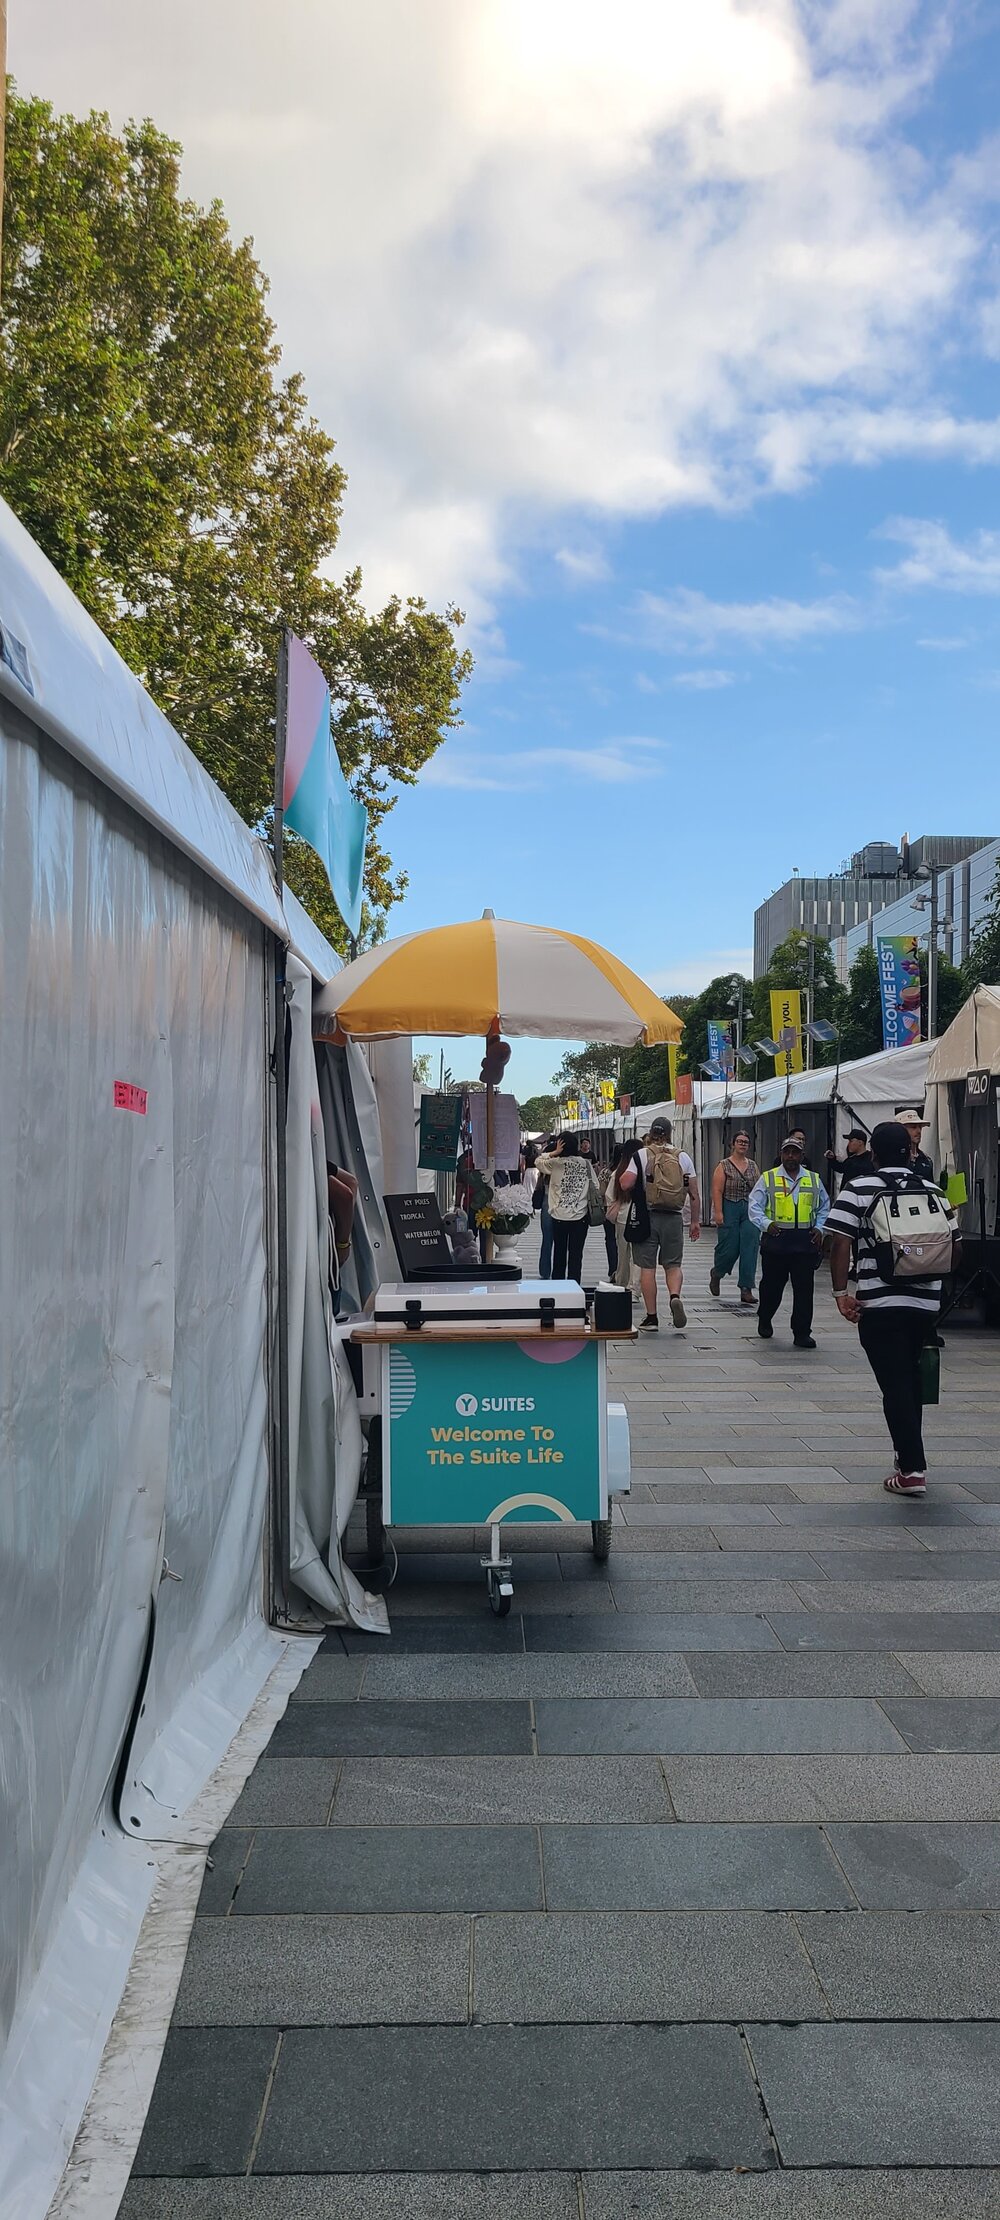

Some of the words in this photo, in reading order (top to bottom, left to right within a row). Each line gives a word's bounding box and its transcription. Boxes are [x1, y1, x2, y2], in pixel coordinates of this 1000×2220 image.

[881, 942, 896, 981] FEST
[782, 1001, 793, 1022] you.
[885, 984, 898, 1049] ELCOME
[710, 1024, 718, 1047] FEST
[404, 1230, 441, 1239] WATERMELON
[481, 1397, 536, 1412] SUITES
[430, 1426, 526, 1442] Welcome
[530, 1425, 555, 1441] To
[426, 1449, 465, 1465] The
[470, 1447, 522, 1465] Suite
[527, 1446, 564, 1464] Life
